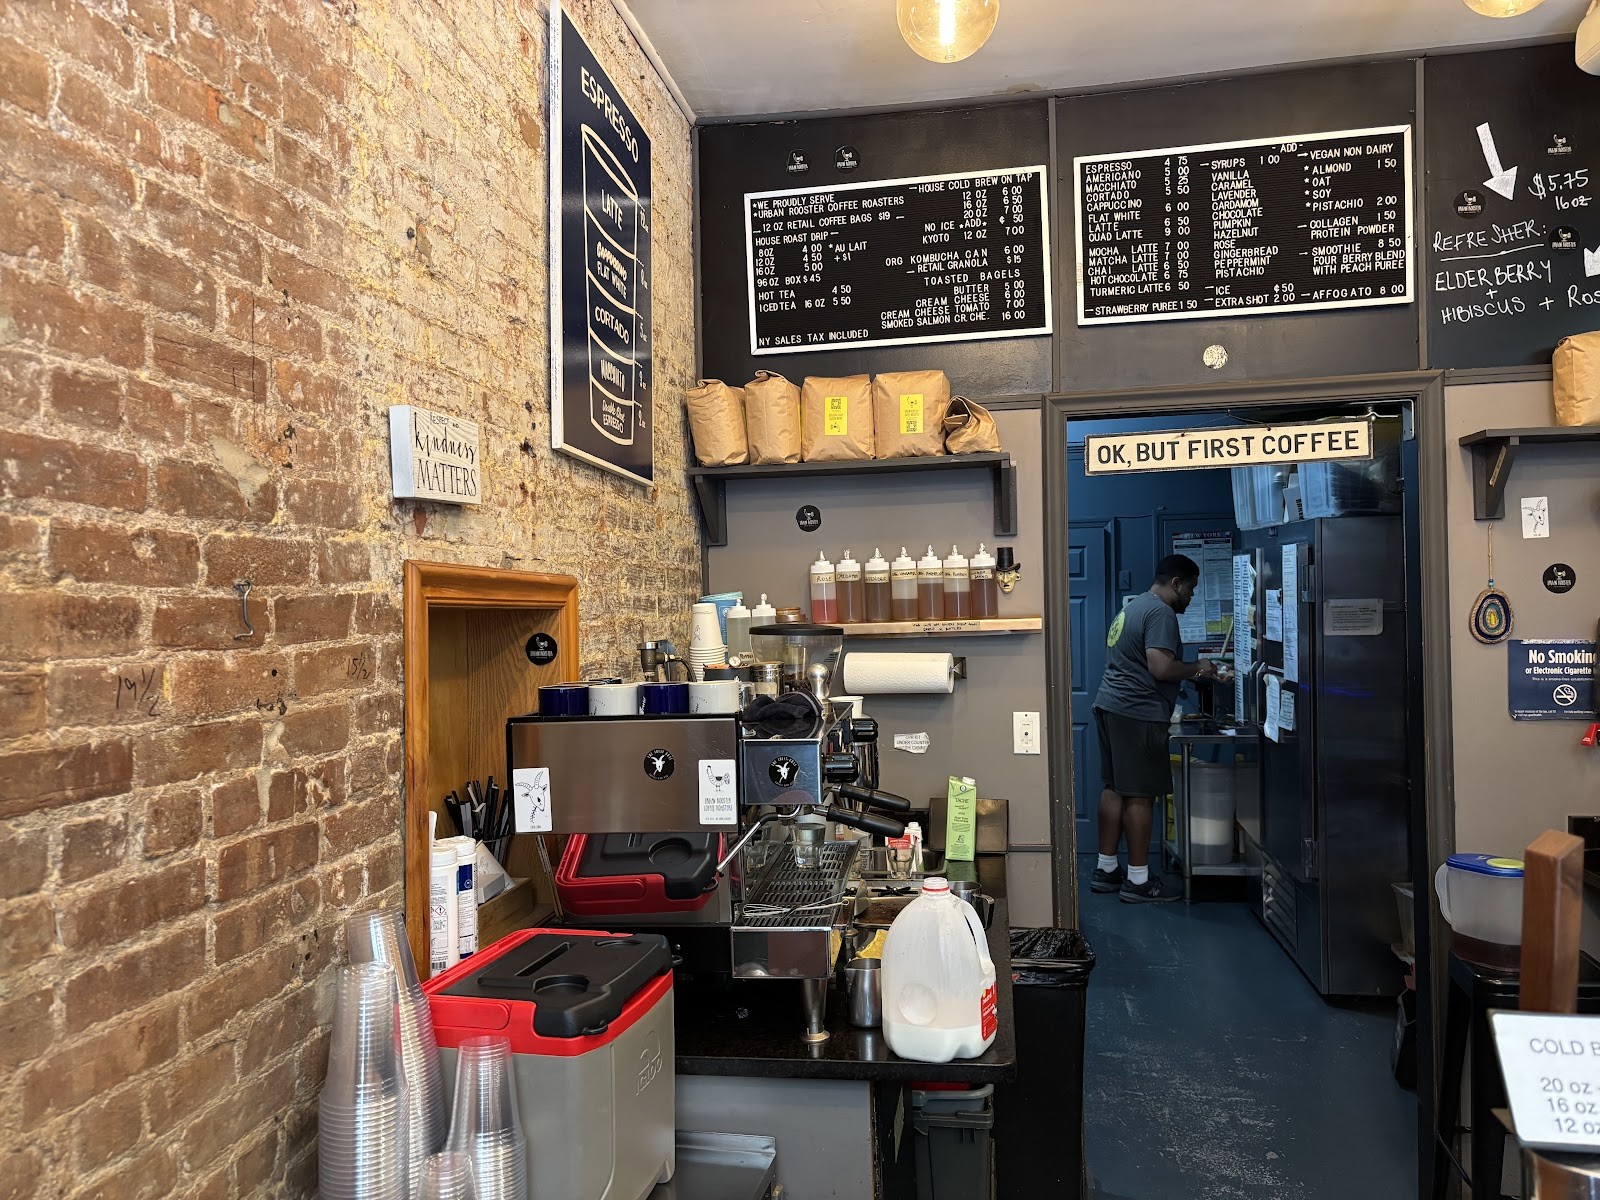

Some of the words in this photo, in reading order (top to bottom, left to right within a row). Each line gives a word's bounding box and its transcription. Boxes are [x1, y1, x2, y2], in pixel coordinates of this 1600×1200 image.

[581, 65, 639, 164] ESPRESSO
[1280, 143, 1297, 153] ADD
[1310, 148, 1340, 160] VEGAN
[1344, 146, 1362, 157] NON
[1367, 143, 1393, 155] DAIRY
[1085, 161, 1132, 174] ESPRESSO
[1211, 158, 1246, 170] SYRUPS
[1312, 162, 1352, 175] ALMOND
[918, 182, 945, 193] HOUSE
[948, 180, 970, 191] COLD
[975, 176, 998, 188] BREW
[1001, 175, 1013, 184] ON
[1015, 173, 1033, 183] TAP
[1085, 170, 1141, 184] AMERICANO
[1211, 170, 1250, 182] VANILLA
[1312, 176, 1331, 187] OAT
[1085, 180, 1137, 194] MACCHIATO
[1211, 179, 1254, 192] CARAMEL
[1528, 169, 1589, 200] $5.75
[1086, 190, 1130, 202] CORTADO
[1211, 189, 1257, 202] LAVENDER
[1312, 189, 1331, 200] SOY
[757, 201, 769, 210] WE
[772, 196, 807, 209] PROUDLY
[810, 194, 835, 204] SERVE
[758, 208, 784, 219] URBAN
[789, 204, 824, 216] ROOSTER
[828, 200, 859, 212] COFFEE
[862, 196, 904, 209] ROASTERS
[1086, 199, 1143, 212] CAPPUCCINO
[1212, 198, 1259, 211] CARDAMOM
[1312, 198, 1364, 212] PISTACHIO
[601, 189, 623, 232] LATTE
[1088, 213, 1110, 223] FLAT
[1114, 210, 1141, 221] WHITE
[1212, 207, 1263, 220] CHOCOLATE
[762, 223, 771, 232] 12
[773, 221, 784, 231] OZ
[787, 219, 815, 230] RETAIL
[819, 215, 847, 227] COFFEE
[850, 213, 872, 224] BAGS
[878, 211, 890, 221] $19
[925, 222, 936, 232] NO
[940, 220, 955, 231] ICE
[1088, 222, 1119, 233] LATTE
[1213, 218, 1252, 230] PUMPKIN
[1310, 216, 1358, 229] COLLAGEN
[755, 235, 781, 246] HOUSE
[783, 232, 807, 244] ROAST
[811, 231, 829, 241] DRIP
[1116, 230, 1143, 241] LATTE
[1213, 226, 1259, 240] HAZELNUT
[1311, 227, 1351, 240] PROTEIN
[1357, 223, 1395, 236] POWDER
[922, 233, 950, 245] KYOTO
[1213, 239, 1236, 250] ROSE
[834, 244, 845, 253] AU
[848, 241, 867, 251] LAIT
[1089, 246, 1119, 257] MOCHA
[1131, 243, 1159, 254] LATTE
[1213, 246, 1279, 259] GINGERBREAD
[1312, 243, 1361, 256] SMOOTHIE
[885, 257, 903, 267] ORG
[910, 251, 960, 265] KOMBUCHA
[965, 248, 988, 259] CAN
[1089, 255, 1128, 267] MATCHA
[1131, 253, 1159, 264] LATTE
[1214, 255, 1271, 269] PEPPERMINT
[1313, 255, 1337, 266] FOUR
[1342, 252, 1373, 264] BERRY
[1375, 249, 1405, 261] BLEND
[917, 262, 945, 273] RETAIL
[947, 257, 988, 270] GRANOLA
[1087, 266, 1111, 276] CHAI
[1132, 262, 1159, 273] LATTE
[1312, 265, 1337, 276] WITH
[1340, 262, 1372, 274] PEACH
[1375, 259, 1405, 271] PUREE
[924, 273, 969, 286] TOASTED
[980, 268, 1021, 282] BAGELS
[1215, 266, 1265, 279] PISTACHIO
[597, 261, 610, 281] FLAT
[611, 271, 627, 300] WHITE
[785, 275, 801, 285] BOX
[758, 291, 774, 301] HOT
[779, 290, 796, 299] TEA
[953, 283, 989, 295] BUTTER
[1090, 285, 1136, 297] TURMERIC
[1138, 283, 1164, 294] LATTE
[1215, 285, 1231, 296] ICE
[1312, 286, 1372, 300] AFFOGATO
[915, 297, 948, 308] CREAM
[954, 292, 990, 304] CHEESE
[880, 309, 910, 320] CREAM
[914, 306, 950, 317] CHEESE
[954, 302, 990, 314] TOMATO
[1095, 303, 1149, 316] STRAWBERRY
[1152, 301, 1178, 312] PUREE
[1441, 296, 1526, 324] HIBISCUS
[594, 306, 629, 344] CORTADO
[881, 318, 914, 330] SMOKED
[916, 315, 951, 326] SALMON
[758, 337, 771, 346] NY
[775, 334, 802, 345] SALES
[807, 332, 824, 343] TAX
[828, 329, 869, 341] INCLUDED
[1097, 444, 1132, 467] OK,
[1136, 440, 1180, 462] BUT
[1188, 435, 1255, 459] FIRST
[1261, 429, 1359, 455] COFFEE
[417, 458, 477, 497] MATTERS
[1528, 649, 1545, 664] No
[1533, 666, 1563, 675] Electronic
[1564, 666, 1592, 676] Cigarette
[1529, 1038, 1584, 1056] COLD
[1540, 1077, 1563, 1093] 20
[1570, 1082, 1593, 1095] oz
[1548, 1098, 1569, 1113] 16
[1575, 1102, 1599, 1115] oz
[1555, 1118, 1578, 1133] 12
